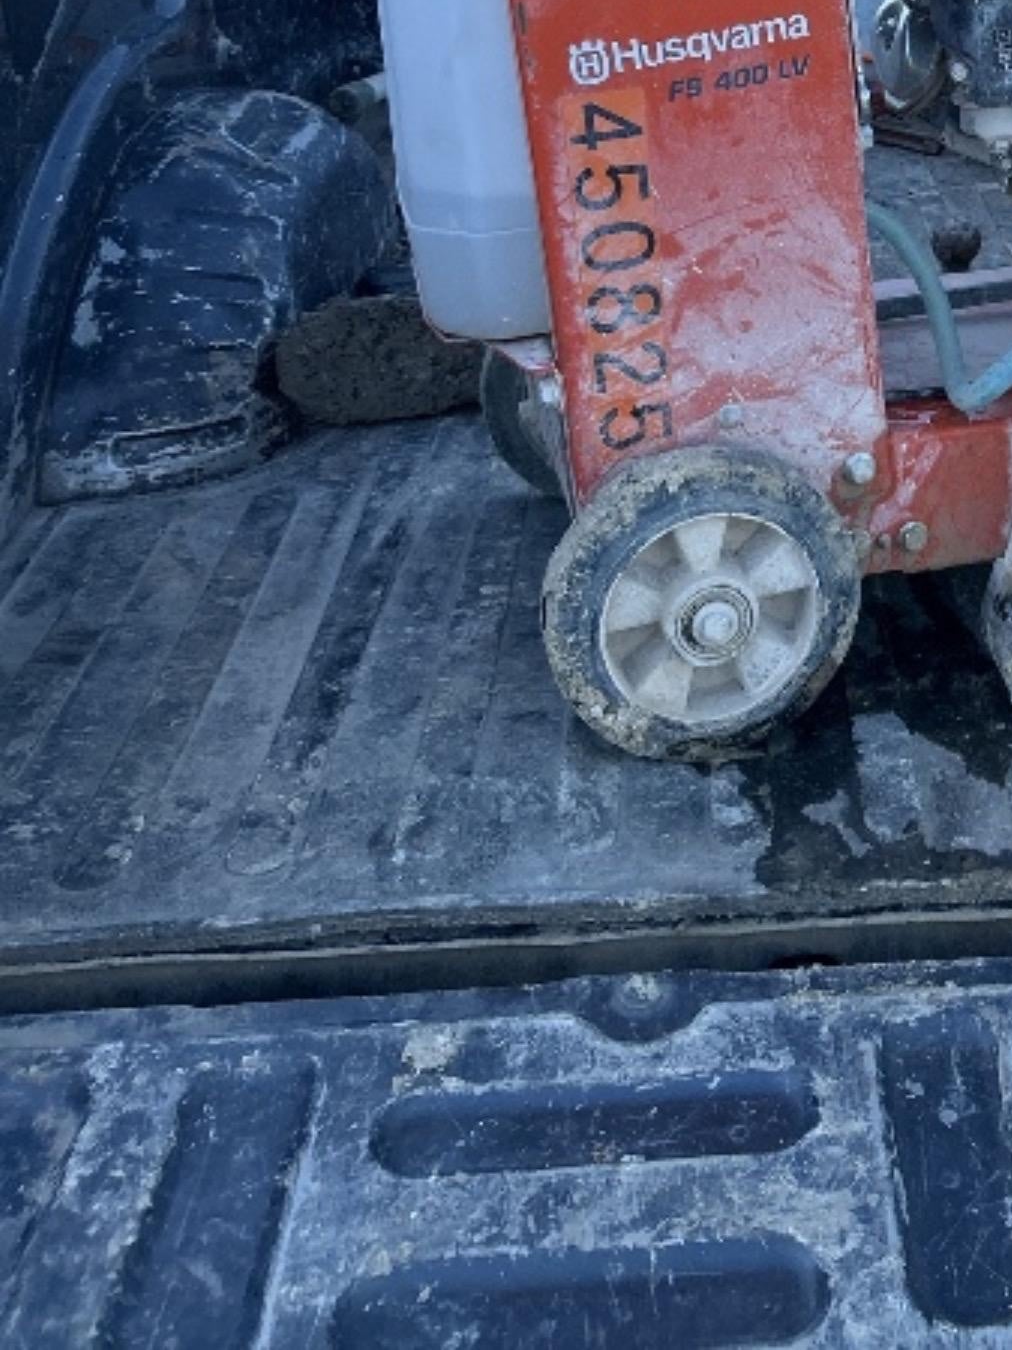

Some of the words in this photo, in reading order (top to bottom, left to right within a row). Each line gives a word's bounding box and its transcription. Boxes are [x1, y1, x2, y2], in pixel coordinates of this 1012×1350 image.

[612, 13, 810, 72] Husqvarna
[668, 78, 702, 102] FS
[714, 65, 770, 92] 400
[778, 52, 811, 80] LV
[570, 101, 673, 450] 450825
